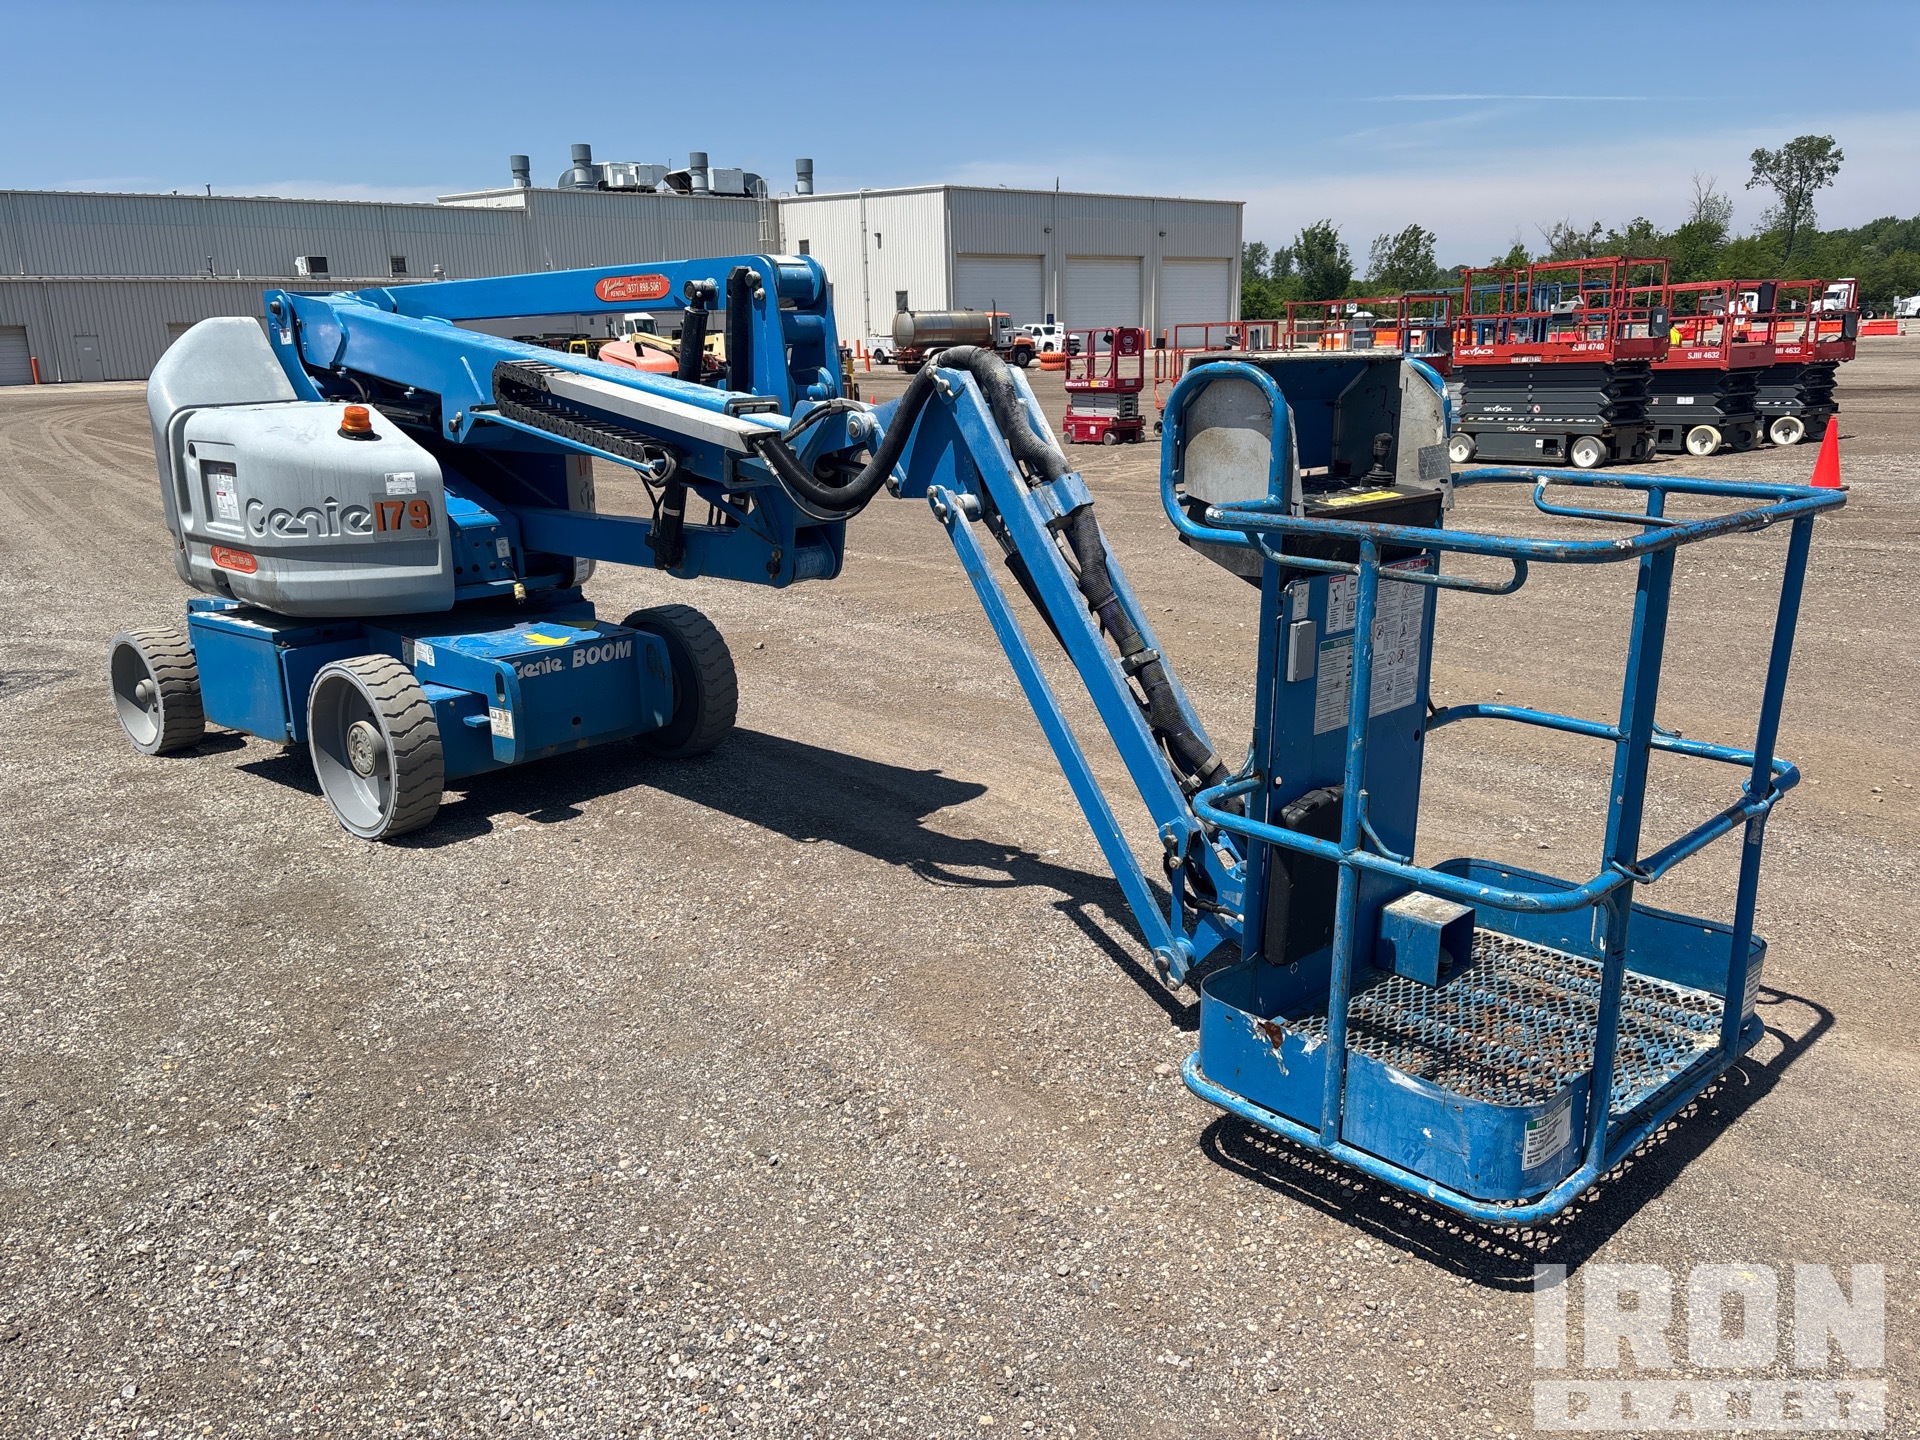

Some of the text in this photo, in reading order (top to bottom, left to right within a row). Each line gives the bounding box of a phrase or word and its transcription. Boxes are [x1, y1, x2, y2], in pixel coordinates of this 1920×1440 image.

[627, 284, 639, 294] (937)
[1588, 343, 1605, 351] 4740
[1785, 346, 1801, 354] 4632
[1460, 347, 1494, 356] SKYJACK
[1703, 351, 1720, 359] 4632
[1483, 405, 1513, 413] SKYJACK
[246, 496, 374, 538] Genie
[374, 499, 432, 532] 179
[511, 640, 632, 680] Genie BOOM
